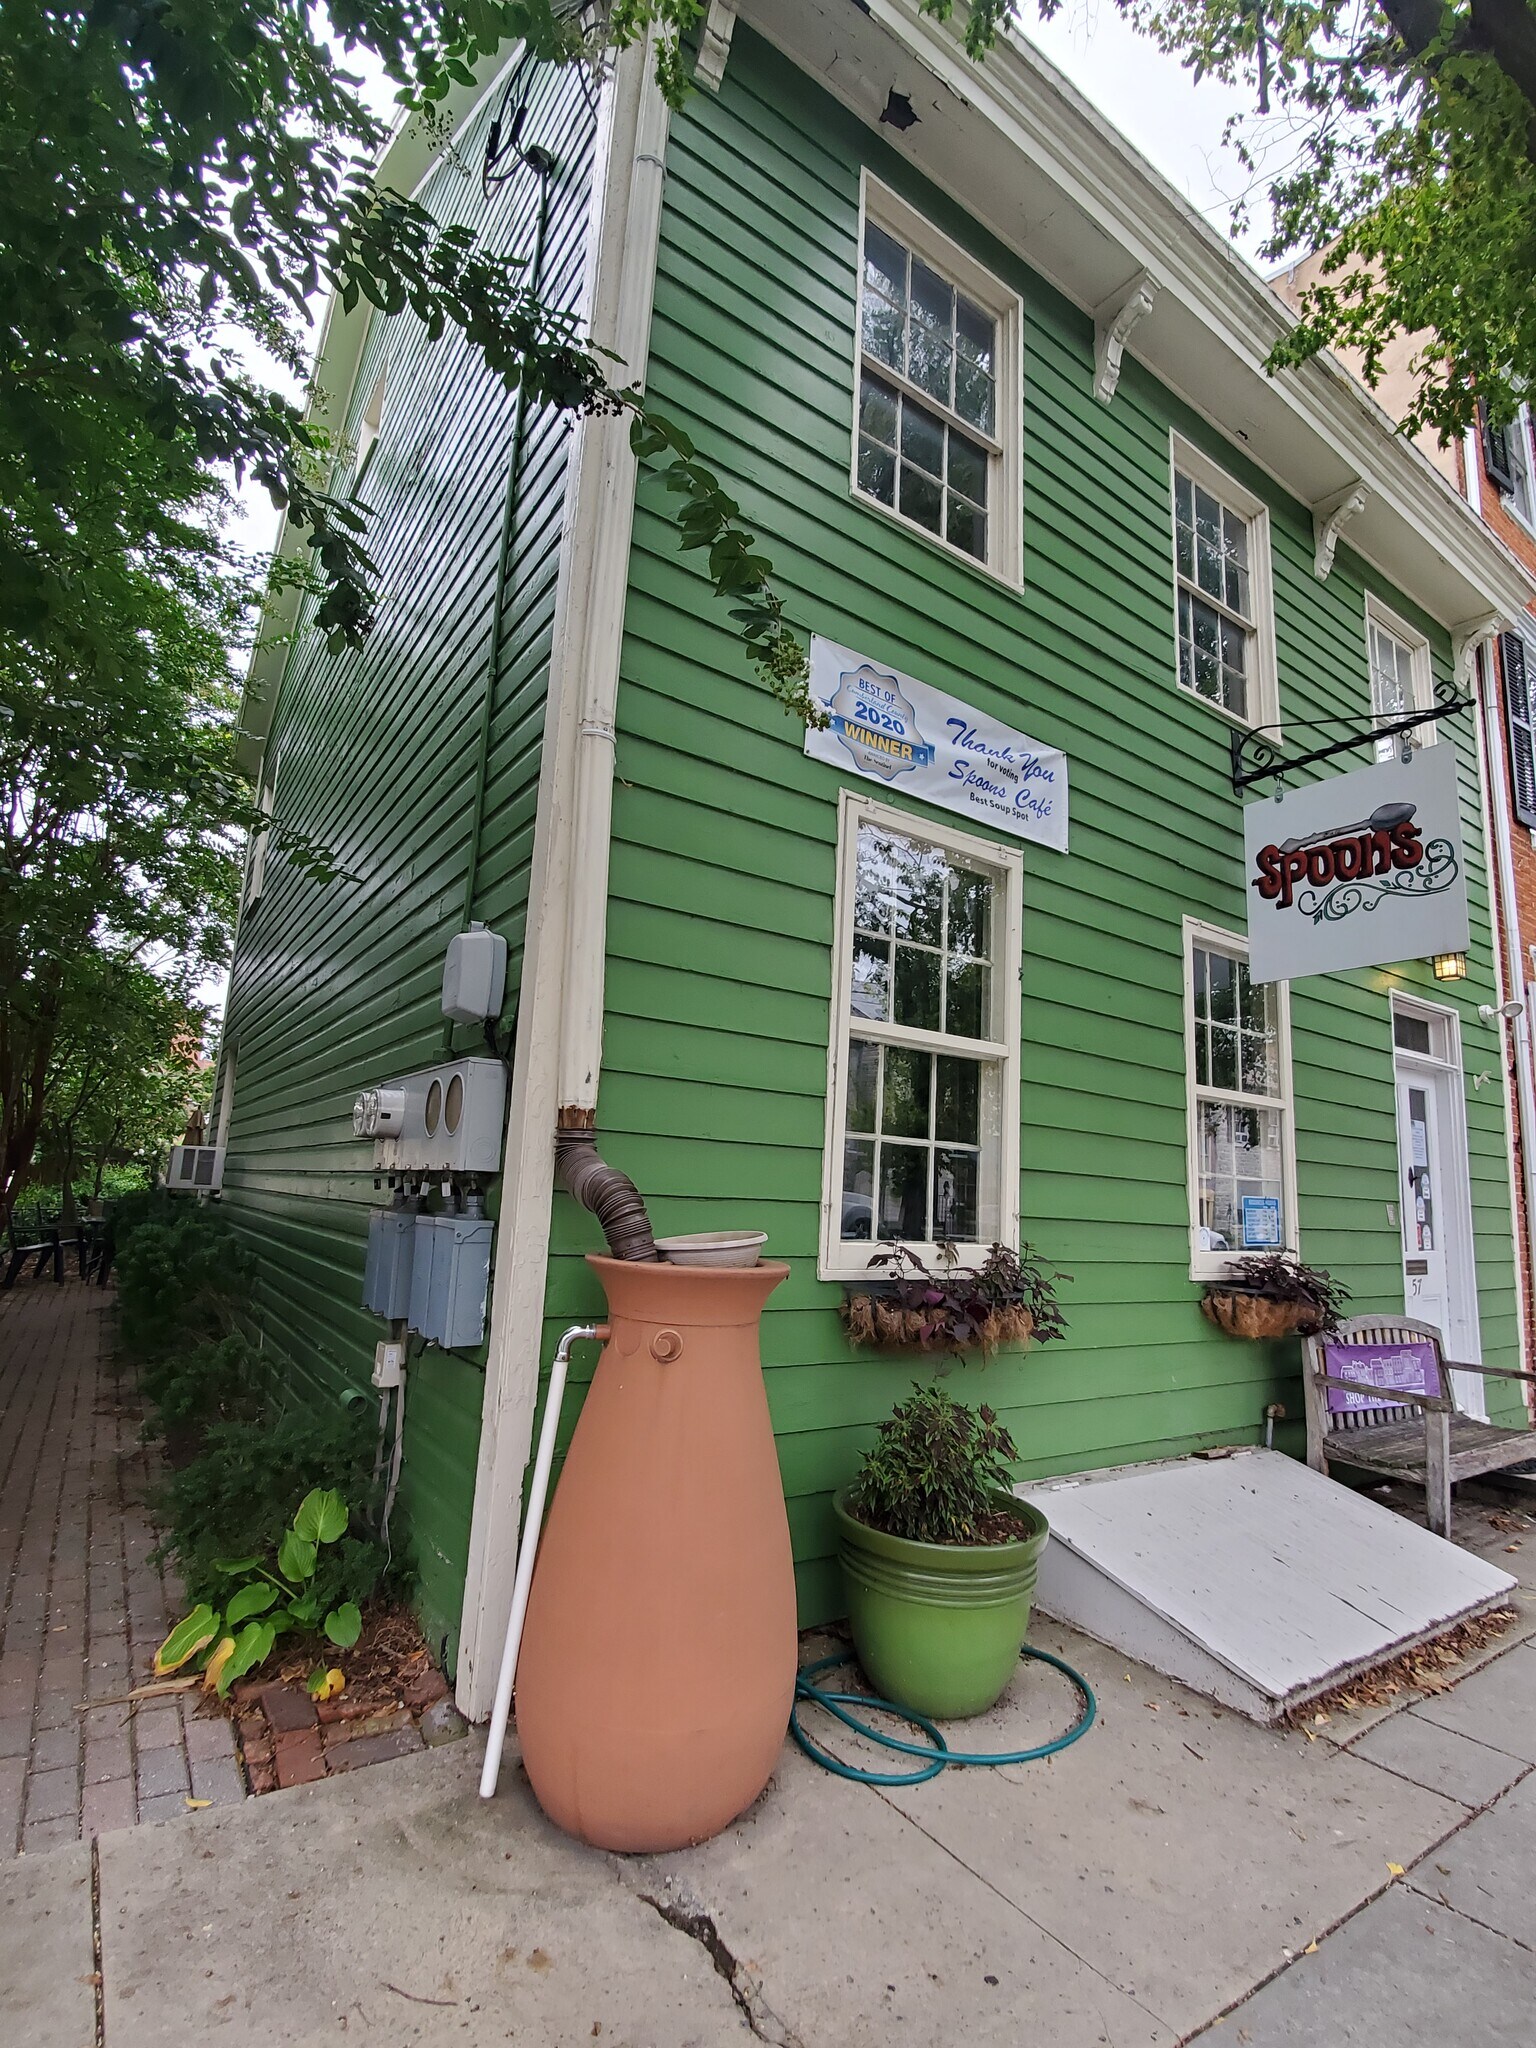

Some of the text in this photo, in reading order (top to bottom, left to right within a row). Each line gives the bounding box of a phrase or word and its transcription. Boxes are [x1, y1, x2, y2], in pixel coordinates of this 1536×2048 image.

[847, 685, 909, 723] Cumberland County
[858, 678, 896, 704] BEST OF
[855, 701, 905, 735] 2020
[844, 720, 913, 760] WINNER
[946, 718, 1055, 783] Thank You
[987, 758, 1019, 784] for voting
[948, 760, 1053, 819] Spoons Café
[970, 792, 1029, 821] Best Soup Spot
